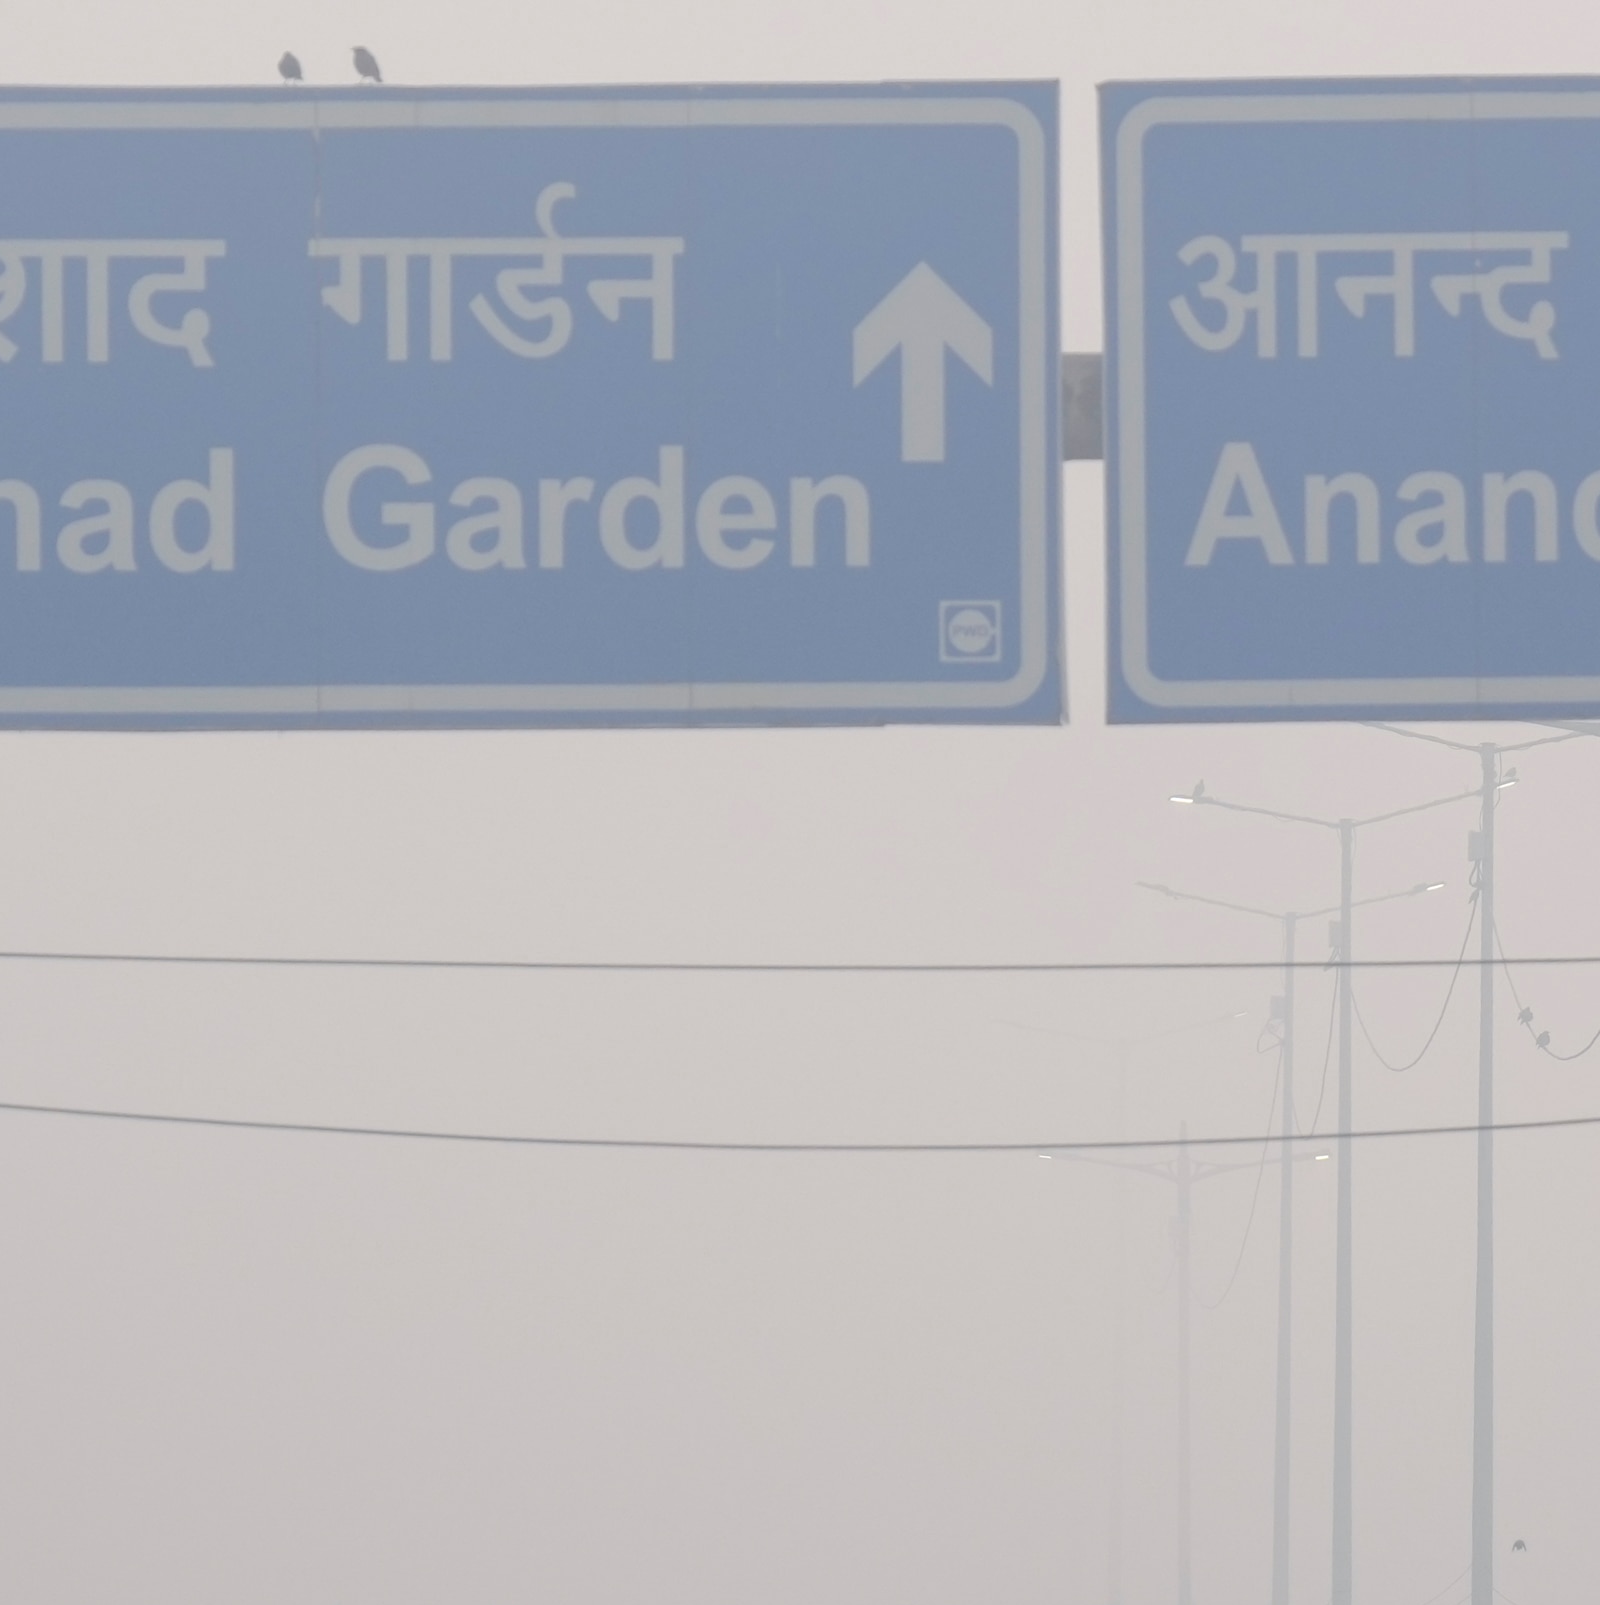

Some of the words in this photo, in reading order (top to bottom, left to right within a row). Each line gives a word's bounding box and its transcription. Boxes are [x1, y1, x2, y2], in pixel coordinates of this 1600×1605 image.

[307, 181, 686, 362] गार्डन
[1168, 230, 1570, 360] आनन्द
[322, 443, 872, 572] Garden
[951, 624, 990, 638] PWD
